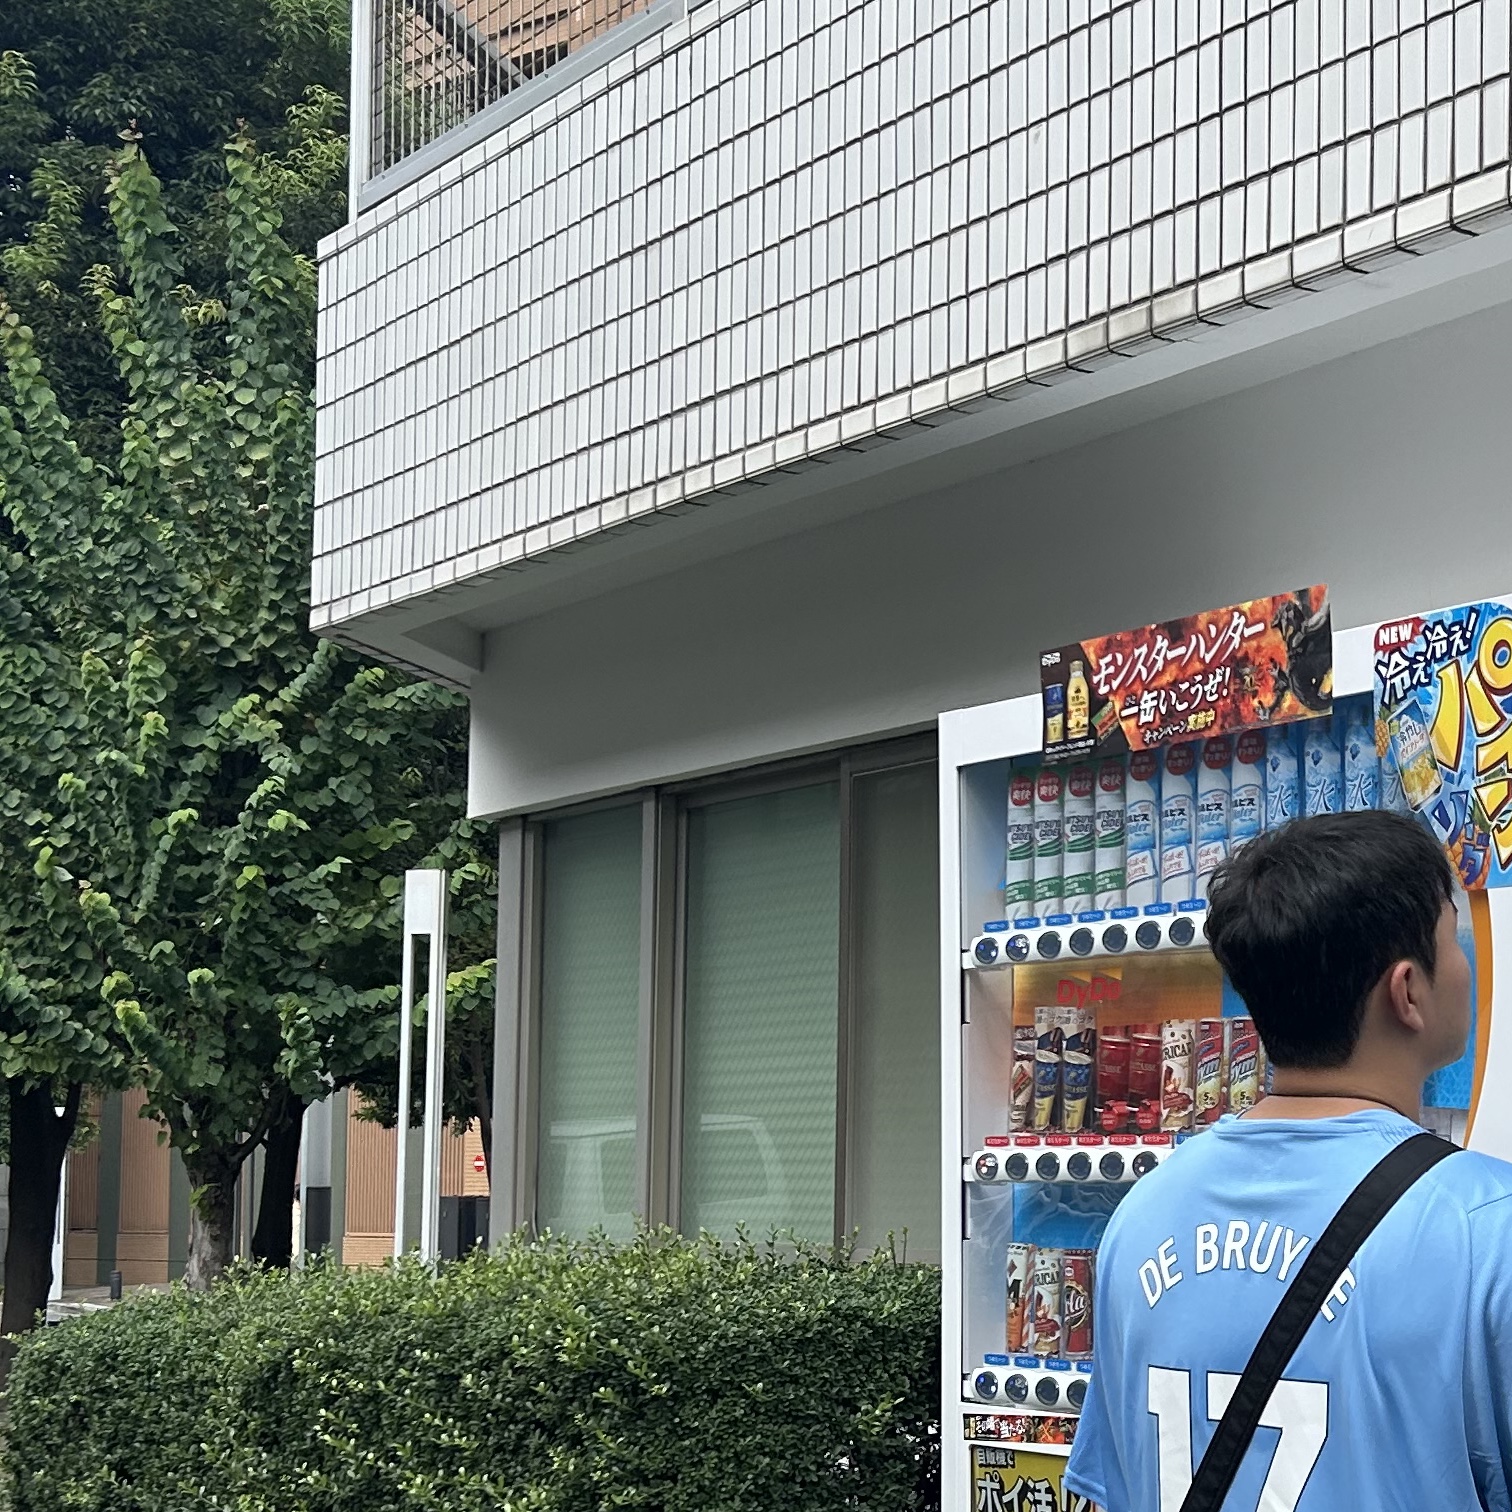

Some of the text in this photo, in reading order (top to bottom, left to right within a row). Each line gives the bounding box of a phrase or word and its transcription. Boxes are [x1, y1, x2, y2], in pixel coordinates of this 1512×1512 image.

[1091, 609, 1266, 695] モンスターハンター
[1377, 622, 1415, 647] NEW
[1378, 611, 1479, 702] 冷え冷え!
[1120, 667, 1232, 726] 一缶いこうぜ!
[1267, 784, 1292, 821] 水
[1309, 778, 1335, 816] 水
[1346, 772, 1373, 810] 水
[1056, 978, 1123, 1010] DyDo
[1138, 1219, 1358, 1323] DE BRUYE
[977, 1448, 1015, 1468] 自販機で
